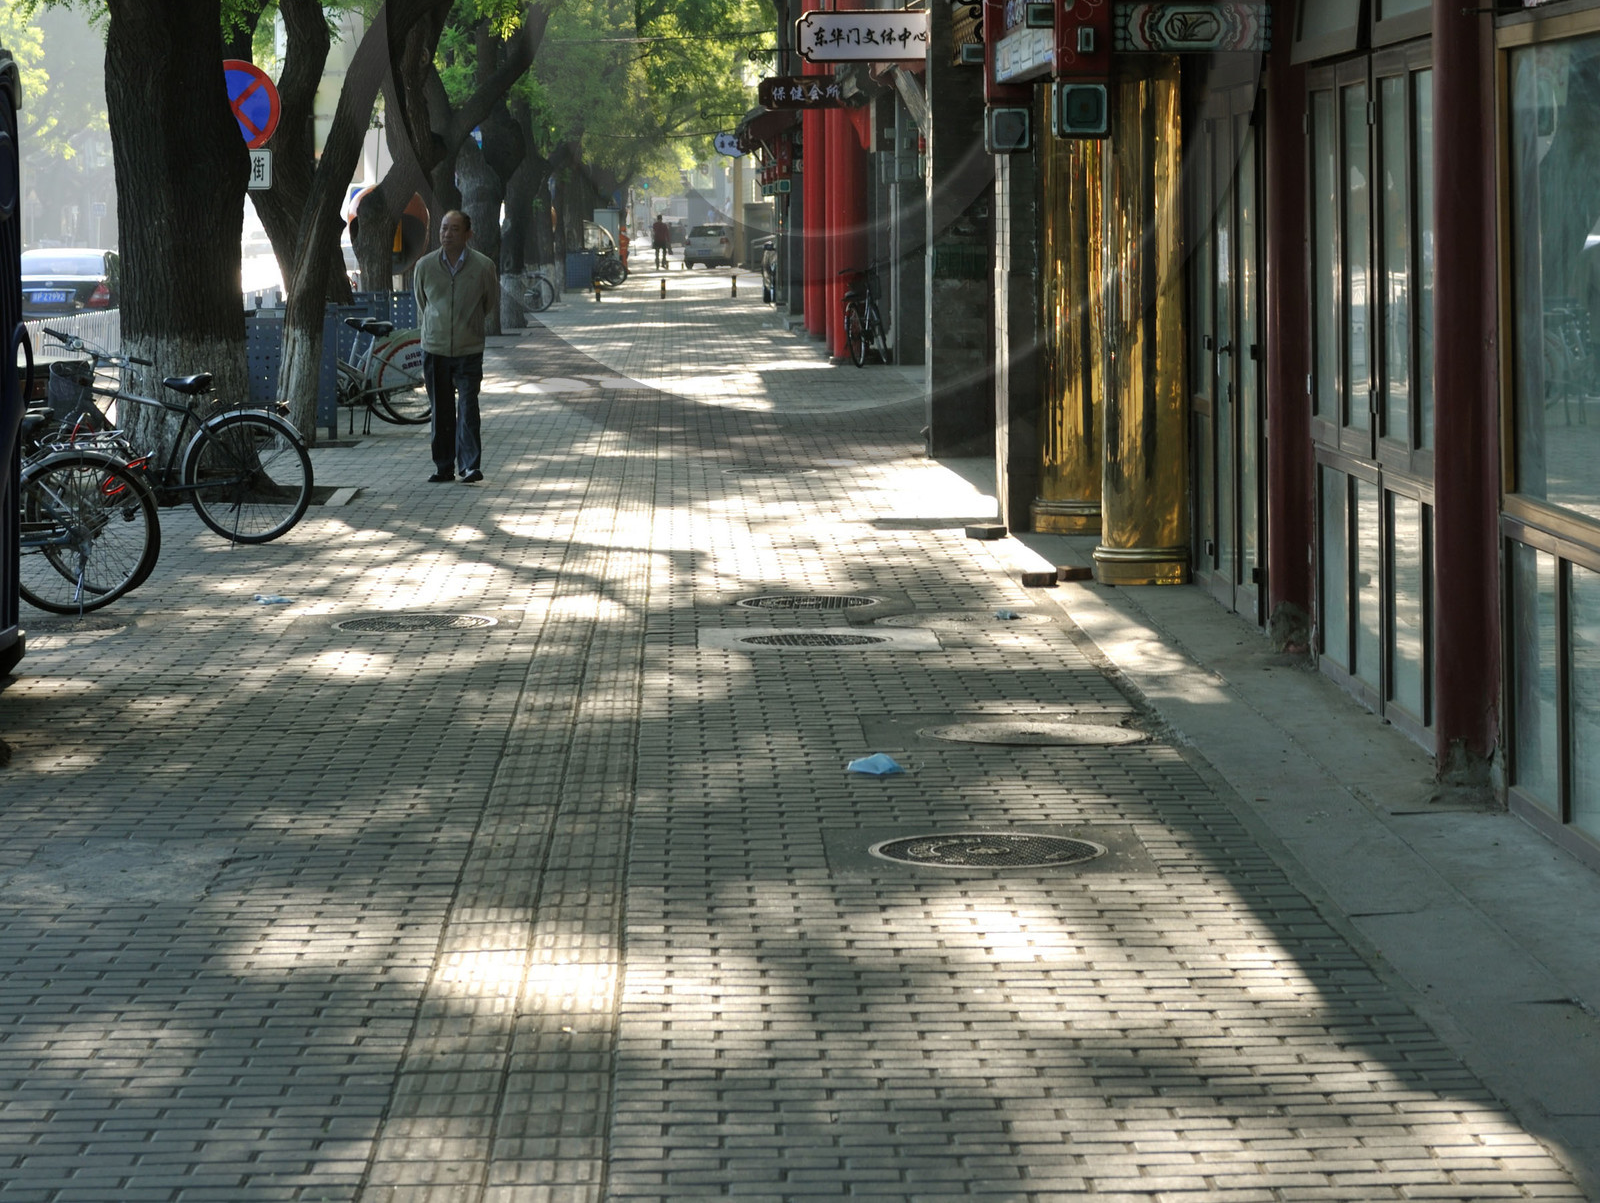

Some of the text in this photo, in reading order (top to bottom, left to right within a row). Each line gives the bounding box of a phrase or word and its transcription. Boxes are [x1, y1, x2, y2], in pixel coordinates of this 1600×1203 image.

[813, 27, 928, 50] 东华门文体中心
[772, 83, 841, 101] 保健会所
[253, 156, 265, 181] 街
